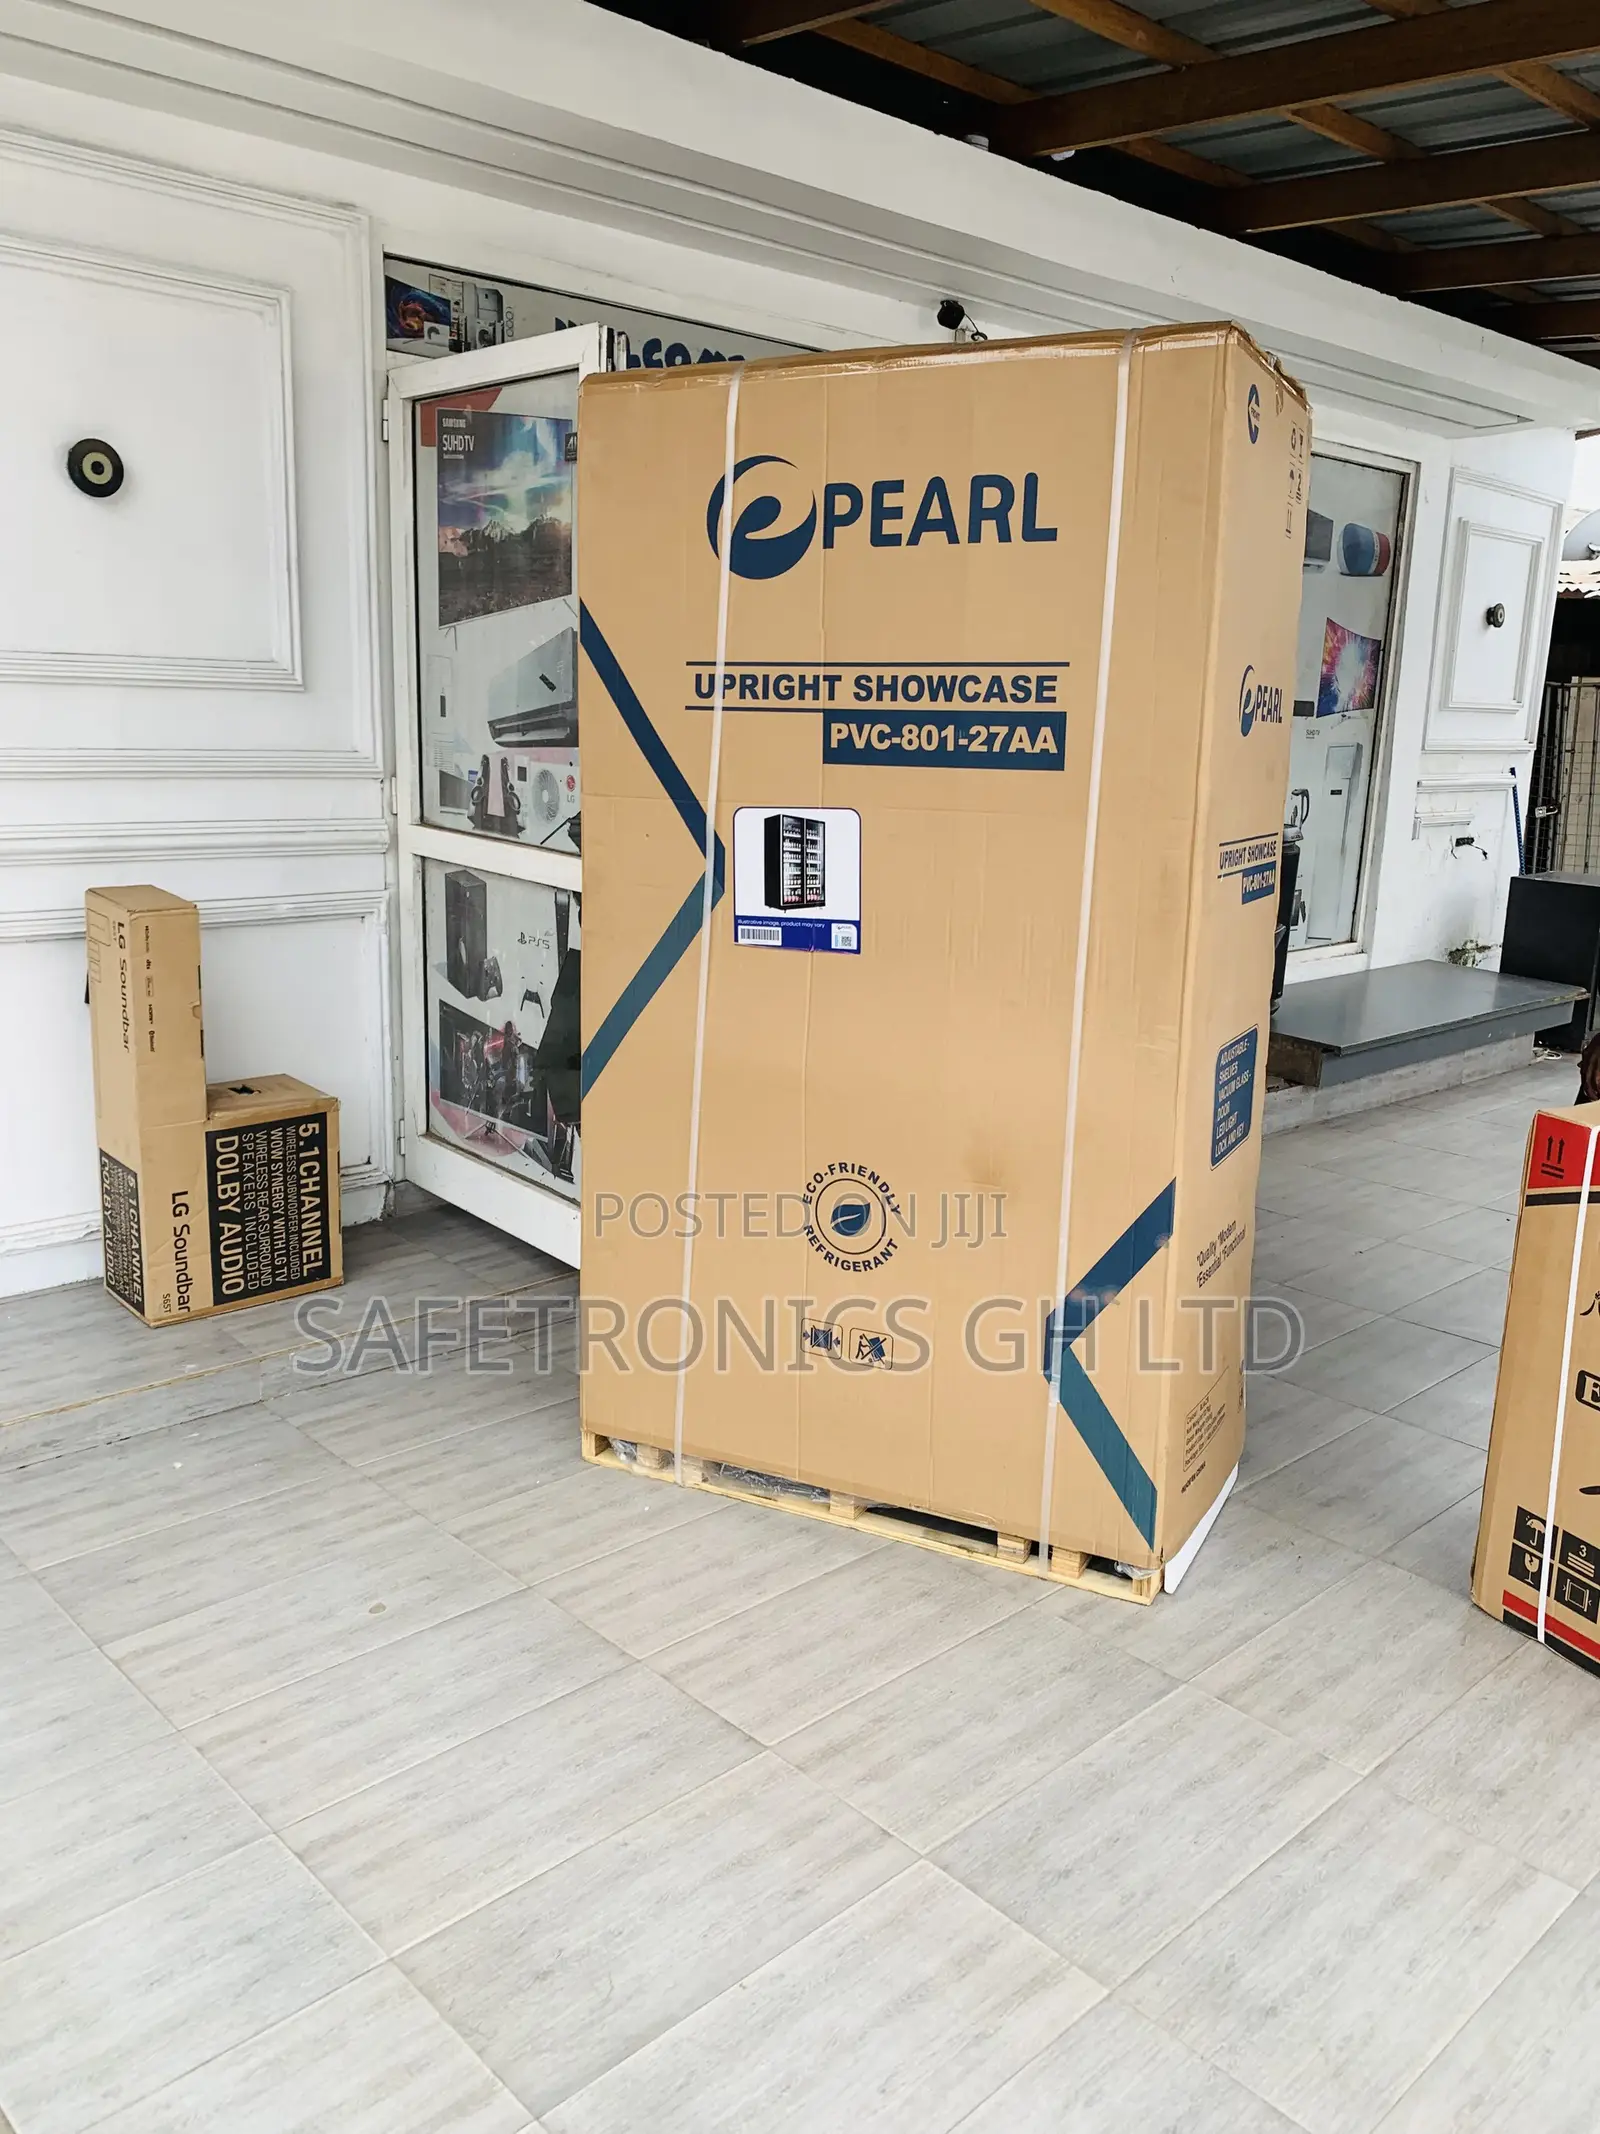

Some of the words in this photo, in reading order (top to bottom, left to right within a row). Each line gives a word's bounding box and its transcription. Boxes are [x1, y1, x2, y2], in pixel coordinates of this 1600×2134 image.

[443, 418, 466, 428] SAMSUNG
[823, 472, 1058, 549] PEARL
[694, 673, 842, 701] UPRIGHT
[853, 674, 1058, 703] SHOWCASE
[1255, 684, 1282, 724] PEARL
[830, 723, 1058, 754] PVC-801-27AA
[1219, 846, 1247, 870] UPRIGHT
[1247, 840, 1276, 864] SHOWCASE
[117, 921, 126, 949] LG
[529, 936, 550, 949] PS5
[119, 958, 130, 1053] Soundbar
[1219, 1062, 1238, 1085] SHELVES
[1217, 1101, 1230, 1122] DOOR
[255, 1131, 268, 1189] WIRELESS
[270, 1128, 283, 1159] WOW
[286, 1126, 297, 1172] WIRELESS
[1215, 1140, 1227, 1157] LOCK
[101, 1156, 111, 1222] DOLBY
[215, 1135, 241, 1213] DOLBY
[242, 1133, 256, 1210] SPEAKERS
[271, 1163, 284, 1215] SYNERGY
[802, 1162, 901, 1215] ECO-FRIENDLY
[172, 1191, 189, 1218] LG
[257, 1192, 269, 1222] REAR
[287, 1175, 298, 1232] SUBWOOFER
[244, 1216, 259, 1290] INCLUDED
[273, 1218, 286, 1249] WITH
[804, 1224, 898, 1272] REFRIGERANT
[105, 1224, 115, 1285] AUDIO
[173, 1224, 193, 1312] Soundbar
[219, 1223, 244, 1295] AUDIO
[258, 1224, 272, 1287] SURROUND
[274, 1251, 287, 1265] LG
[275, 1268, 287, 1281] TV
[289, 1234, 300, 1279] INCLUDED
[162, 1293, 171, 1313] S65T
[1579, 1545, 1587, 1558] 3
